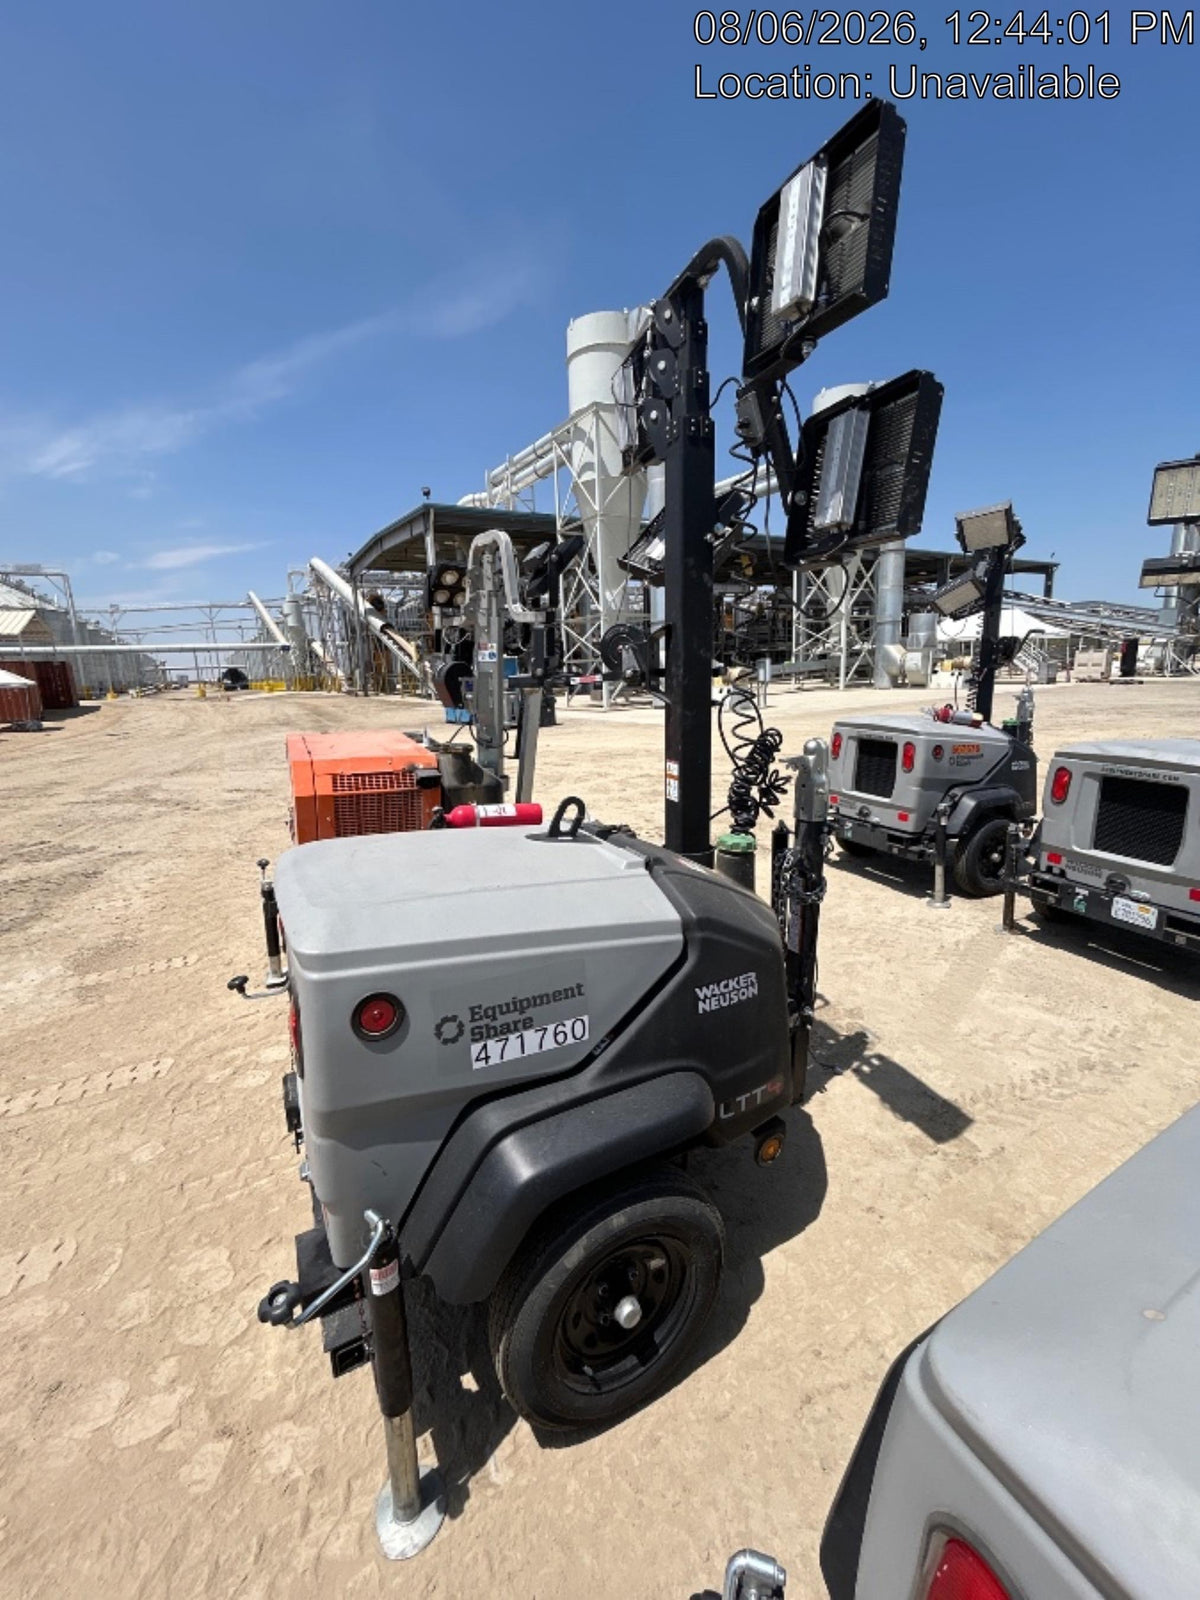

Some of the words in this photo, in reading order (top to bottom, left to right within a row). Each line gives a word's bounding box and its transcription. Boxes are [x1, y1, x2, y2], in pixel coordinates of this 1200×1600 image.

[694, 972, 757, 999] WACKER
[699, 983, 758, 1014] NEUSON
[469, 982, 585, 1023] Equipment
[470, 1016, 535, 1043] Share
[474, 1018, 587, 1066] 471760
